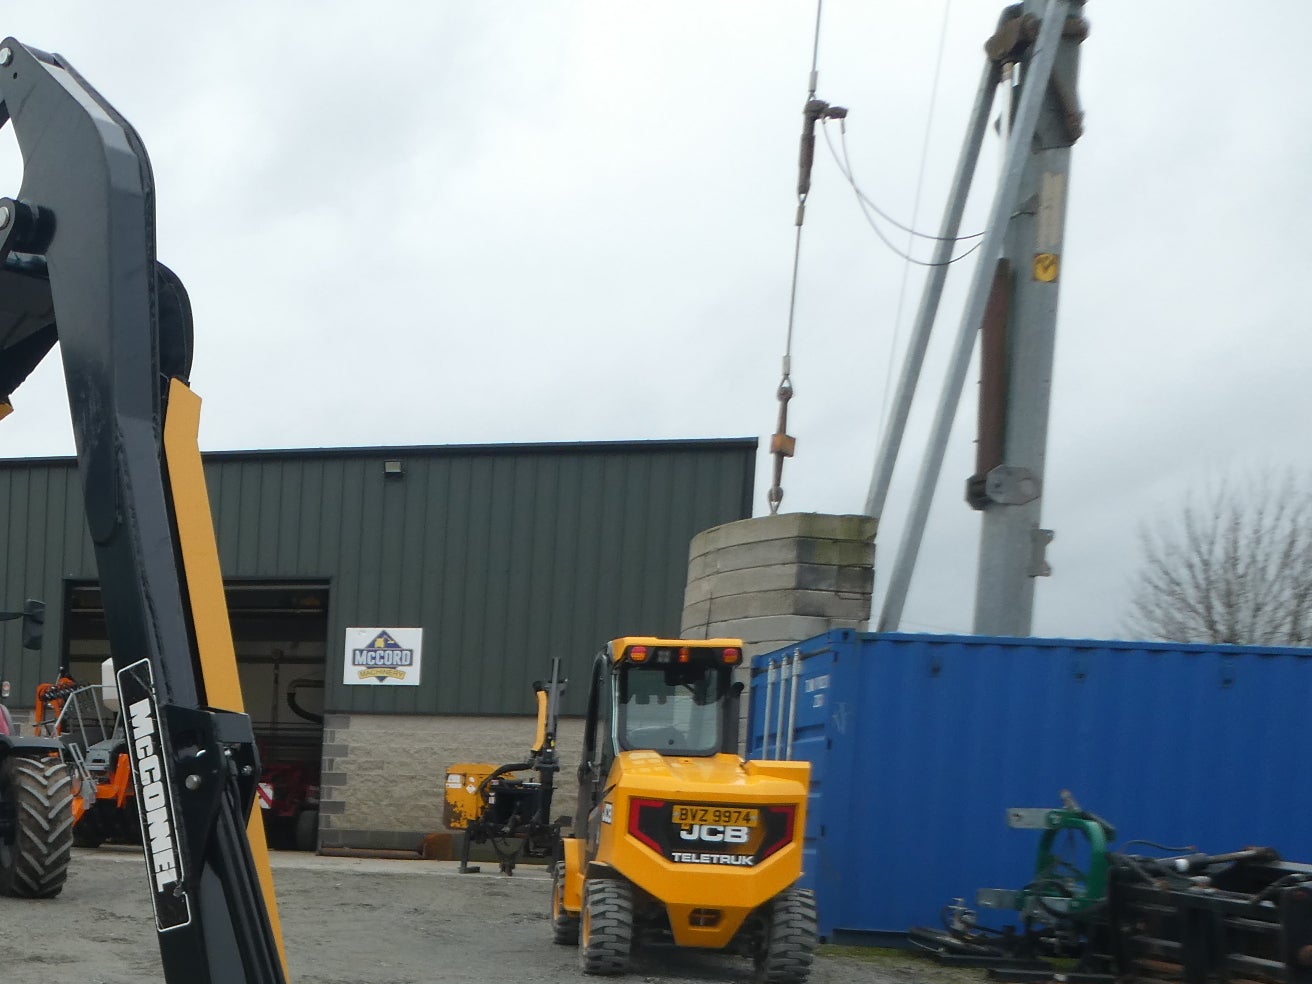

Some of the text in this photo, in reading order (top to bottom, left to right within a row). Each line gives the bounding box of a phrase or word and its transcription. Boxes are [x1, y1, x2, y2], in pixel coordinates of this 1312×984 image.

[354, 650, 411, 665] McCORD
[359, 668, 404, 677] MACHINERY
[679, 808, 751, 824] BVZ 9974
[680, 824, 749, 843] JCB
[672, 852, 754, 866] TELETRUK
